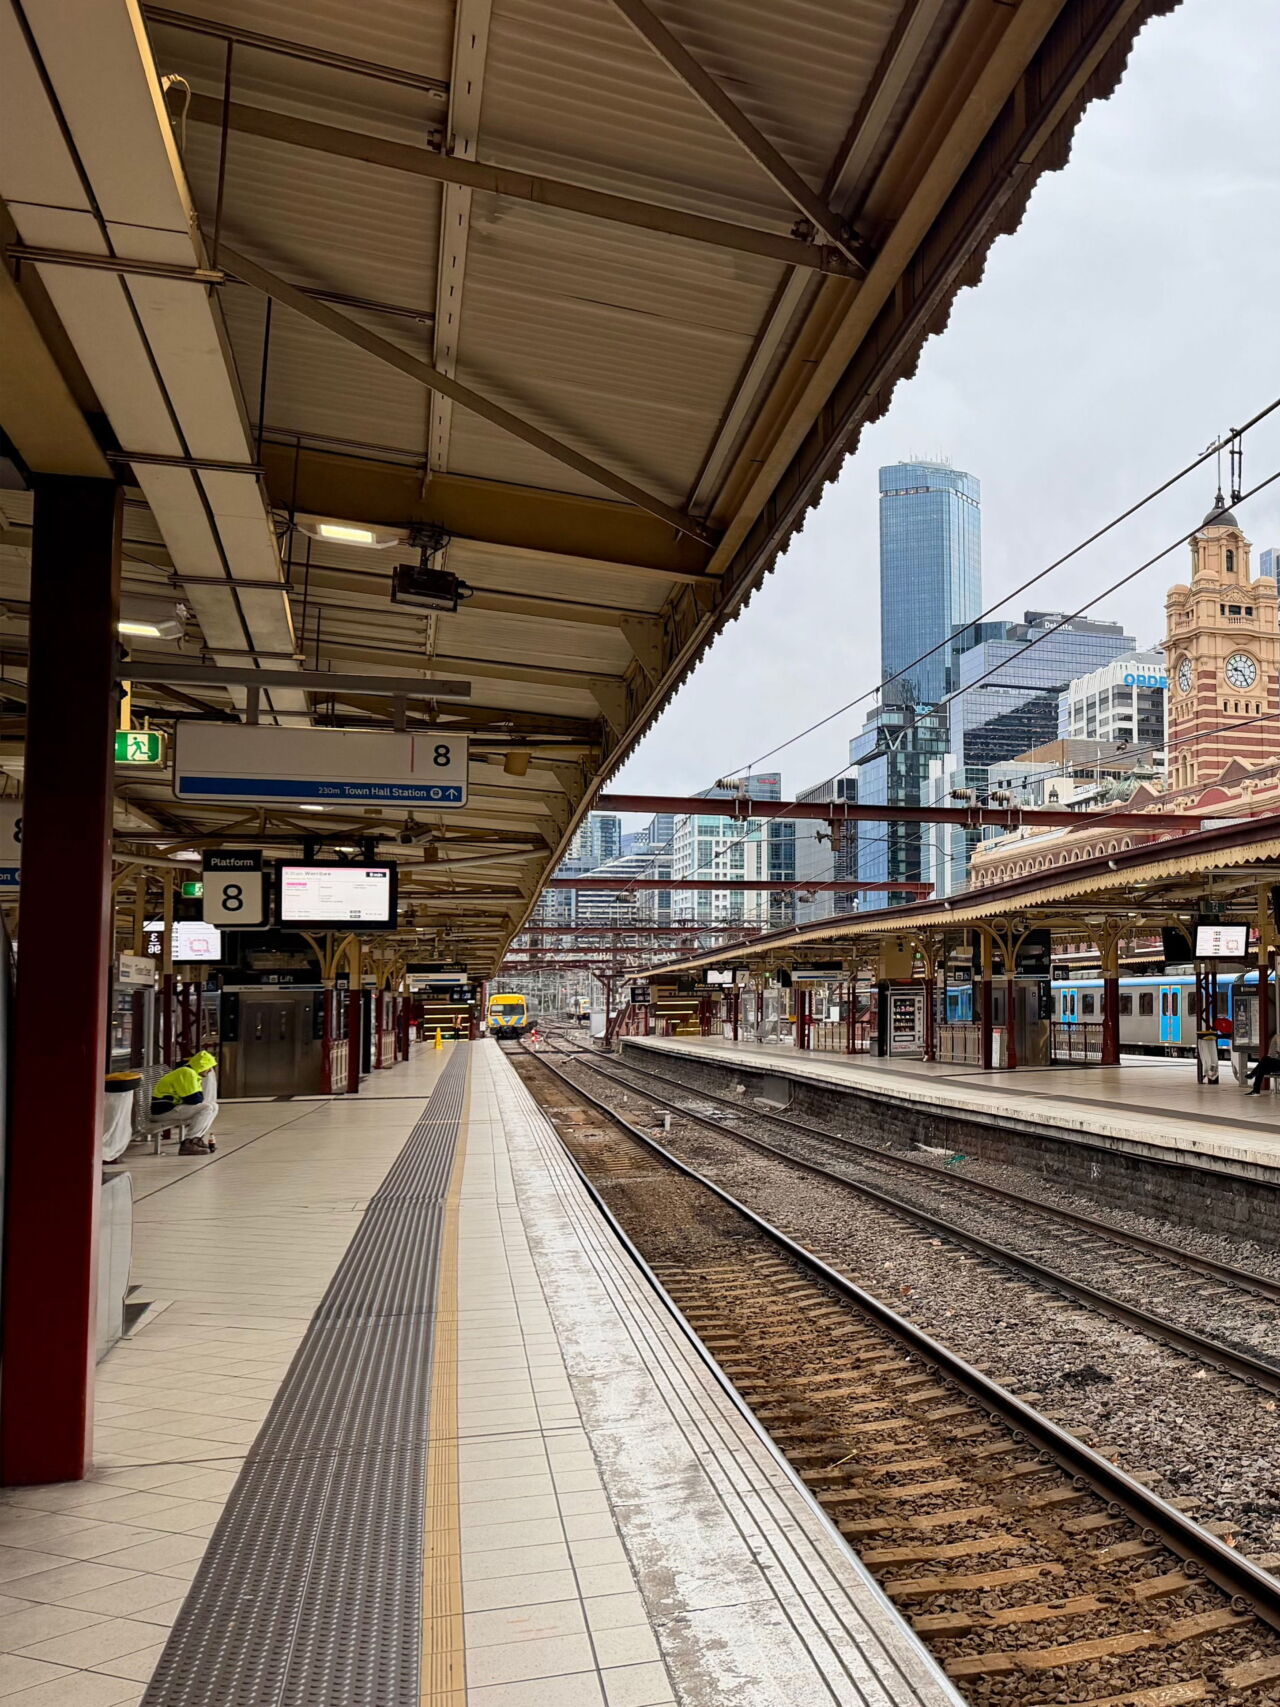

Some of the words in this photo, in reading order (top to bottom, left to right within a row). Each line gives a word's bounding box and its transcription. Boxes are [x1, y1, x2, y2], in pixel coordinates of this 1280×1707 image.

[1045, 621, 1073, 631] Delitte
[433, 744, 451, 767] 8
[344, 786, 370, 795] Town
[371, 788, 390, 796] Hall
[392, 789, 427, 798] Station
[211, 858, 254, 867] Platform
[222, 884, 243, 912] 8
